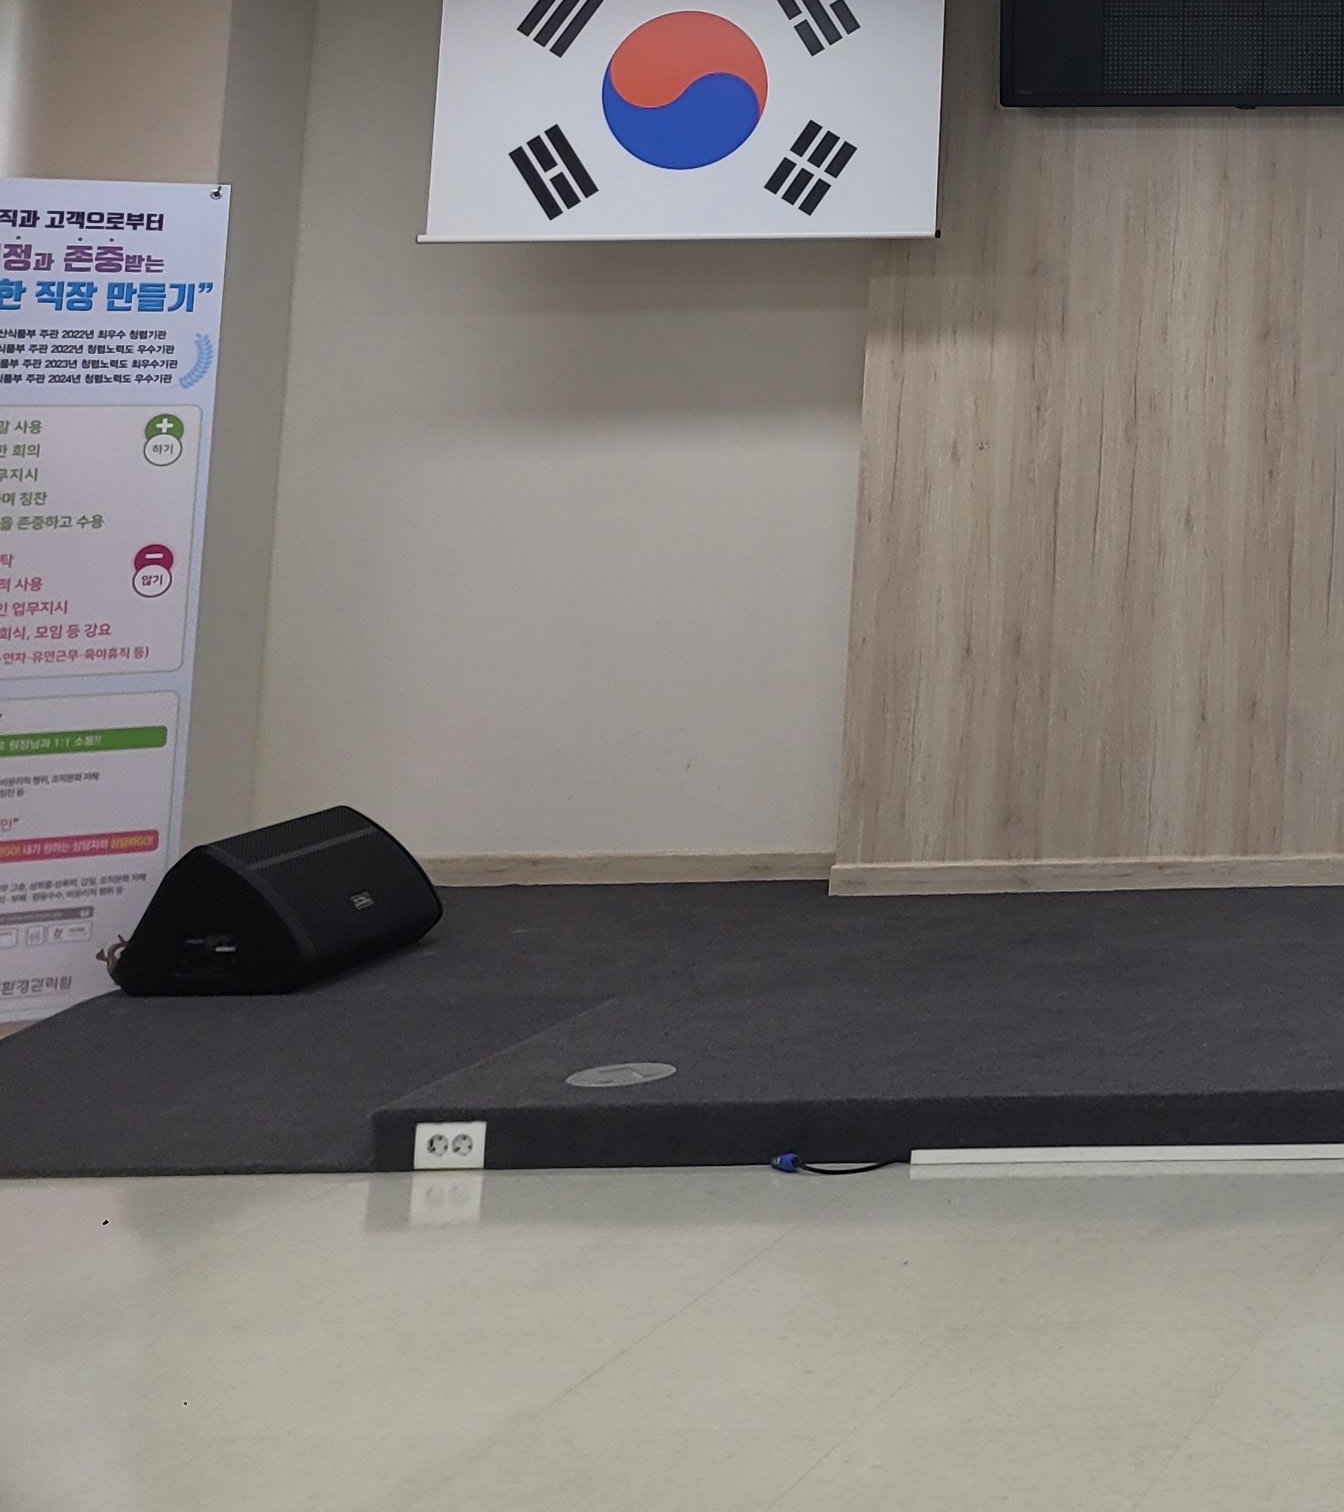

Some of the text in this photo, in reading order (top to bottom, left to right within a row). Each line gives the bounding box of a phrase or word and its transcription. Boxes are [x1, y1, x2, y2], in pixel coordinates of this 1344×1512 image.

[45, 210, 165, 231] 고객으로부터
[0, 243, 165, 273] 정과 존중받는
[36, 280, 98, 312] 직장
[39, 329, 59, 339] 주관
[62, 329, 95, 340] 2022년
[28, 344, 48, 354] 주관
[51, 344, 84, 355] 2022년
[136, 344, 175, 355] 우수기관
[22, 359, 42, 369] 주관
[45, 359, 78, 369] 2023년
[0, 374, 23, 384] 품부
[26, 374, 46, 384] 주관
[48, 374, 82, 384] 2024년
[135, 374, 173, 384] 우수기관
[14, 419, 43, 434] 사용
[12, 444, 40, 458] 회의
[152, 444, 174, 455] 하기
[20, 492, 47, 506] 칭찬
[17, 516, 73, 531] 존중하고
[76, 515, 104, 529] 수용
[15, 577, 43, 592] 사용
[12, 600, 68, 617] 업무지시
[34, 625, 63, 639] 모임
[84, 623, 112, 639] 강요
